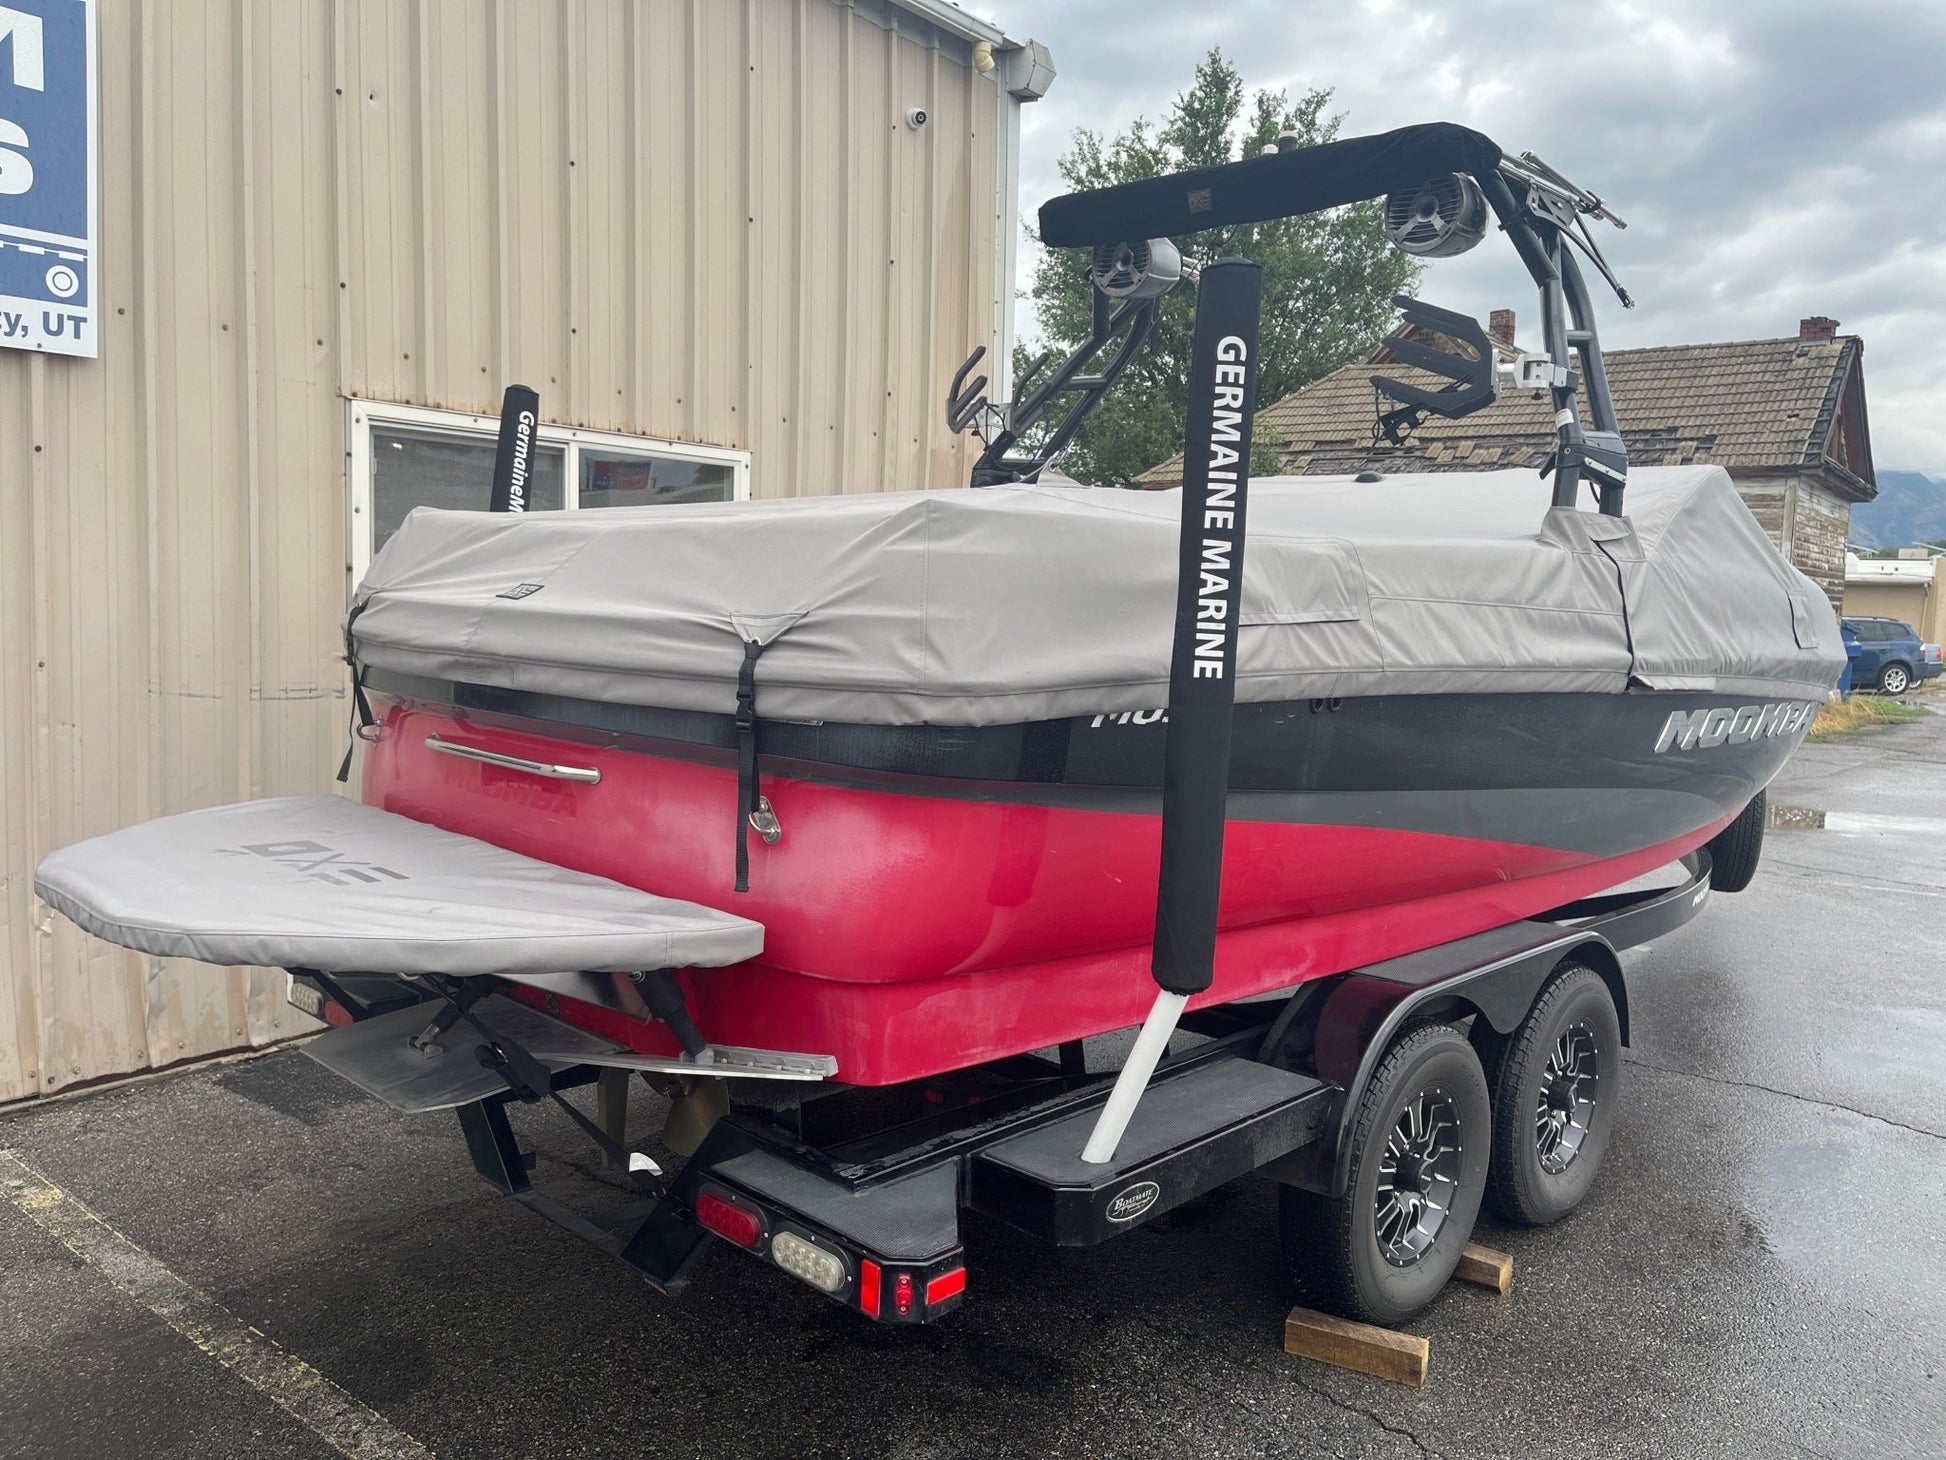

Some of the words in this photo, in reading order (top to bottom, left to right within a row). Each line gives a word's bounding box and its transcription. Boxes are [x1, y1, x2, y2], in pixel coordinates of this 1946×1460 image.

[0, 311, 28, 338] y,
[43, 311, 88, 339] UT
[1203, 335, 1247, 530] GERMAINE
[1193, 538, 1232, 680] MARINE
[1653, 700, 1819, 754] MOOMBA
